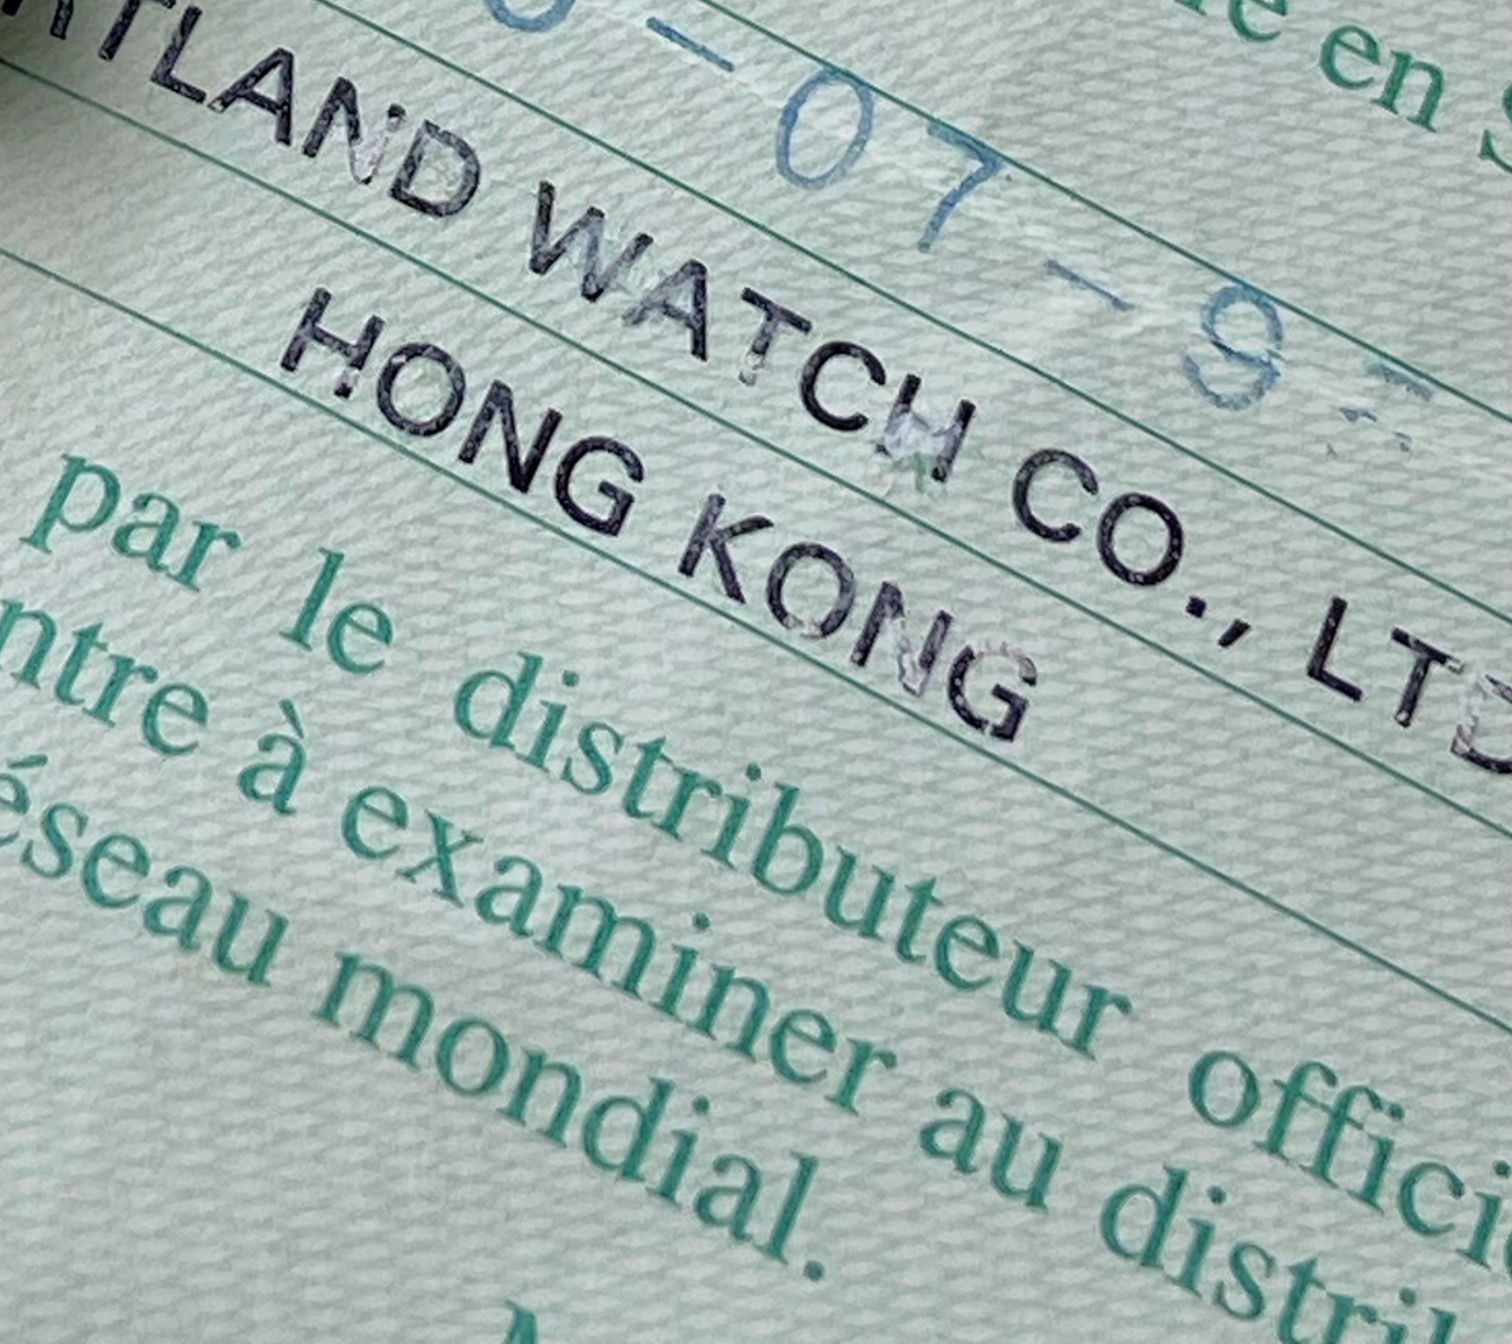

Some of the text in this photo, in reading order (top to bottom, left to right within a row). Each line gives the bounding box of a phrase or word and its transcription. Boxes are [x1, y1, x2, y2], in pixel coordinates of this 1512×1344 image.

[1319, 24, 1445, 133] en
[280, 288, 1038, 742] HONG KONG
[528, 181, 977, 483] WATCH
[1013, 448, 1251, 648] CO.,
[19, 453, 242, 592] par
[280, 547, 394, 674] le
[453, 651, 1133, 1061] distributeur
[1188, 1049, 1512, 1278] offici
[237, 699, 308, 815] à
[341, 785, 898, 1115] examiner
[919, 1087, 1064, 1213] au
[1099, 1162, 1457, 1344] distri
[311, 951, 825, 1281] mondial.
